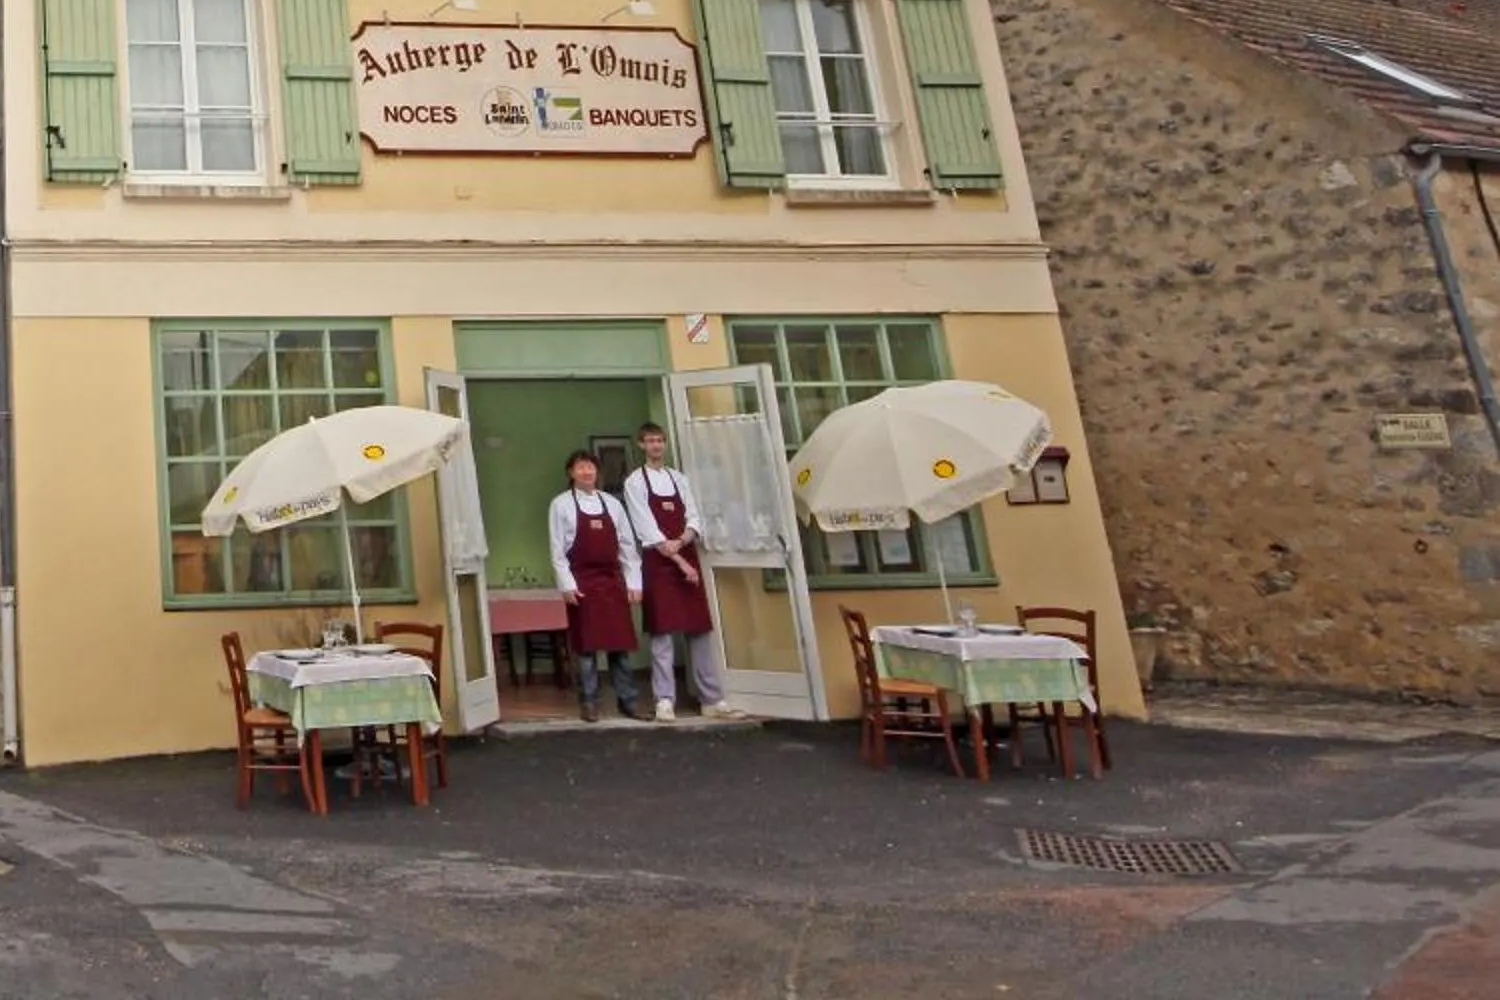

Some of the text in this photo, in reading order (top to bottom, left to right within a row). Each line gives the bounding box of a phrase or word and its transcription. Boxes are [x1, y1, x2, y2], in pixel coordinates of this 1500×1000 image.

[358, 40, 487, 83] Auberge
[504, 39, 538, 70] de
[383, 106, 457, 124] NOCES
[589, 108, 697, 127] BANQUETS
